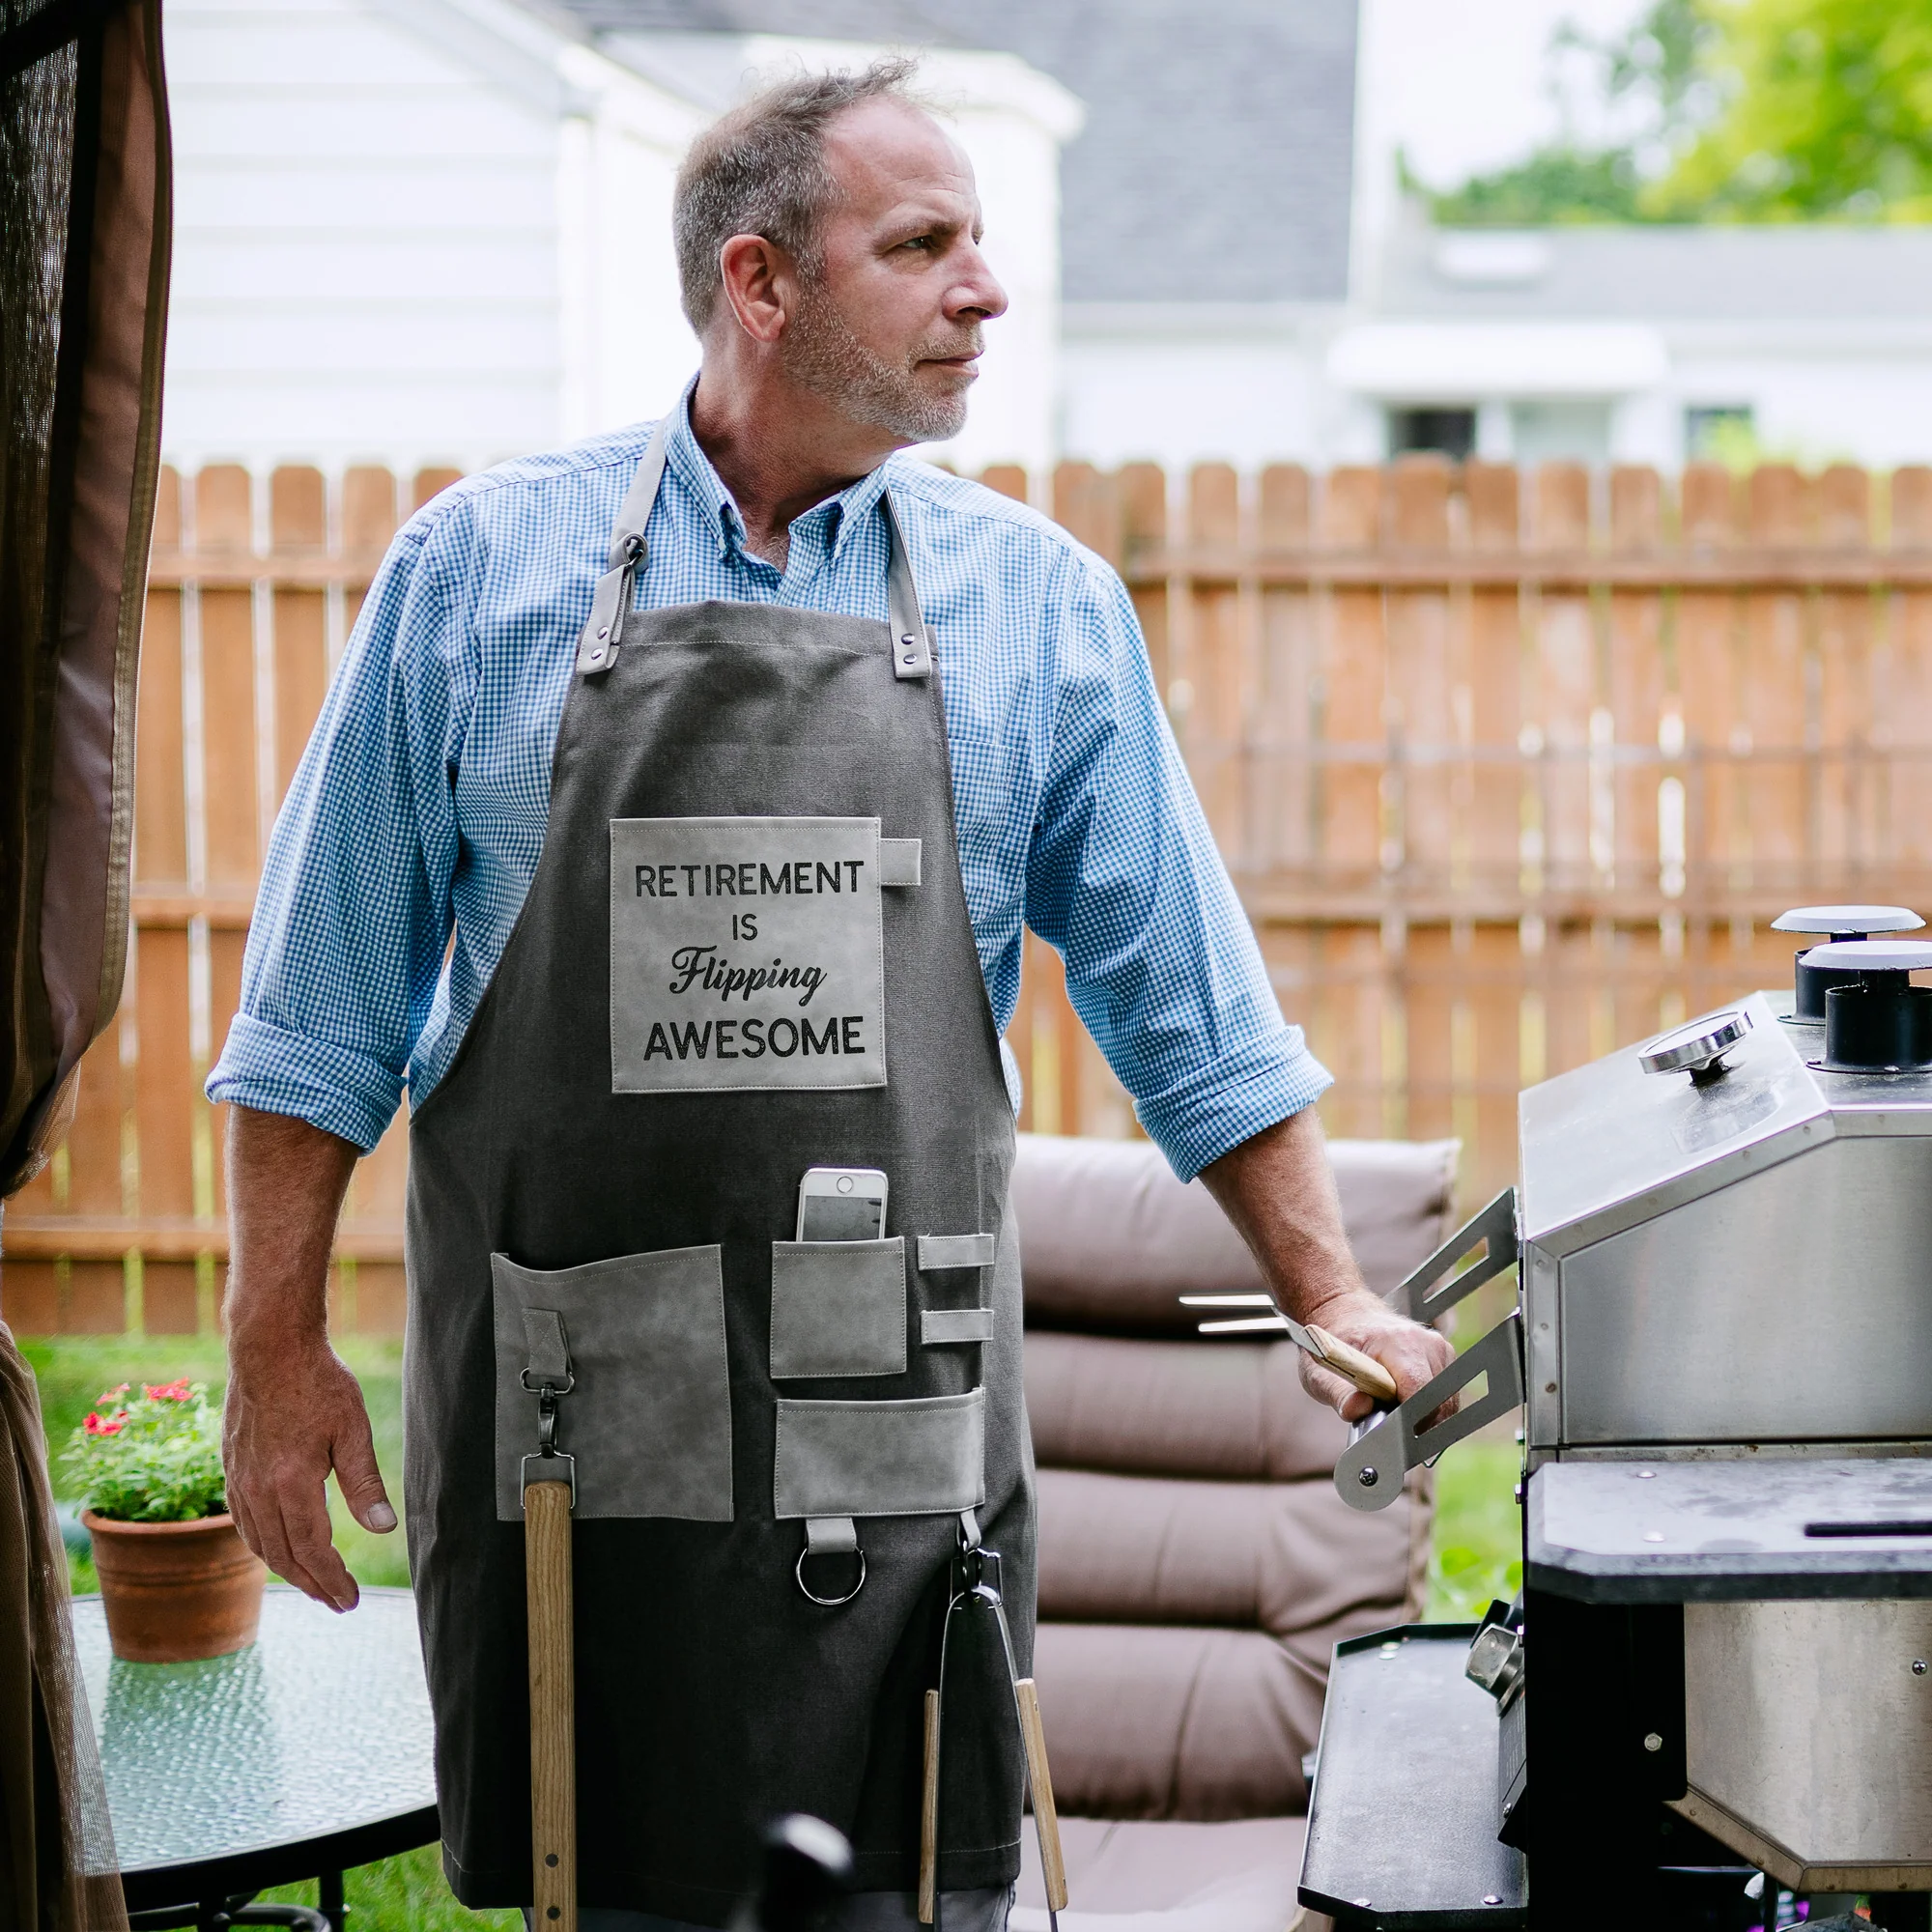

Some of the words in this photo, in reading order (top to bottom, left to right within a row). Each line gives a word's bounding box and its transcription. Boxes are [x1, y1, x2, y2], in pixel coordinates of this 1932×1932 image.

[636, 861, 865, 897] RETIREMENT
[732, 914, 758, 941] IS
[668, 946, 828, 1007] Flipping
[642, 1016, 866, 1061] AWESOME
